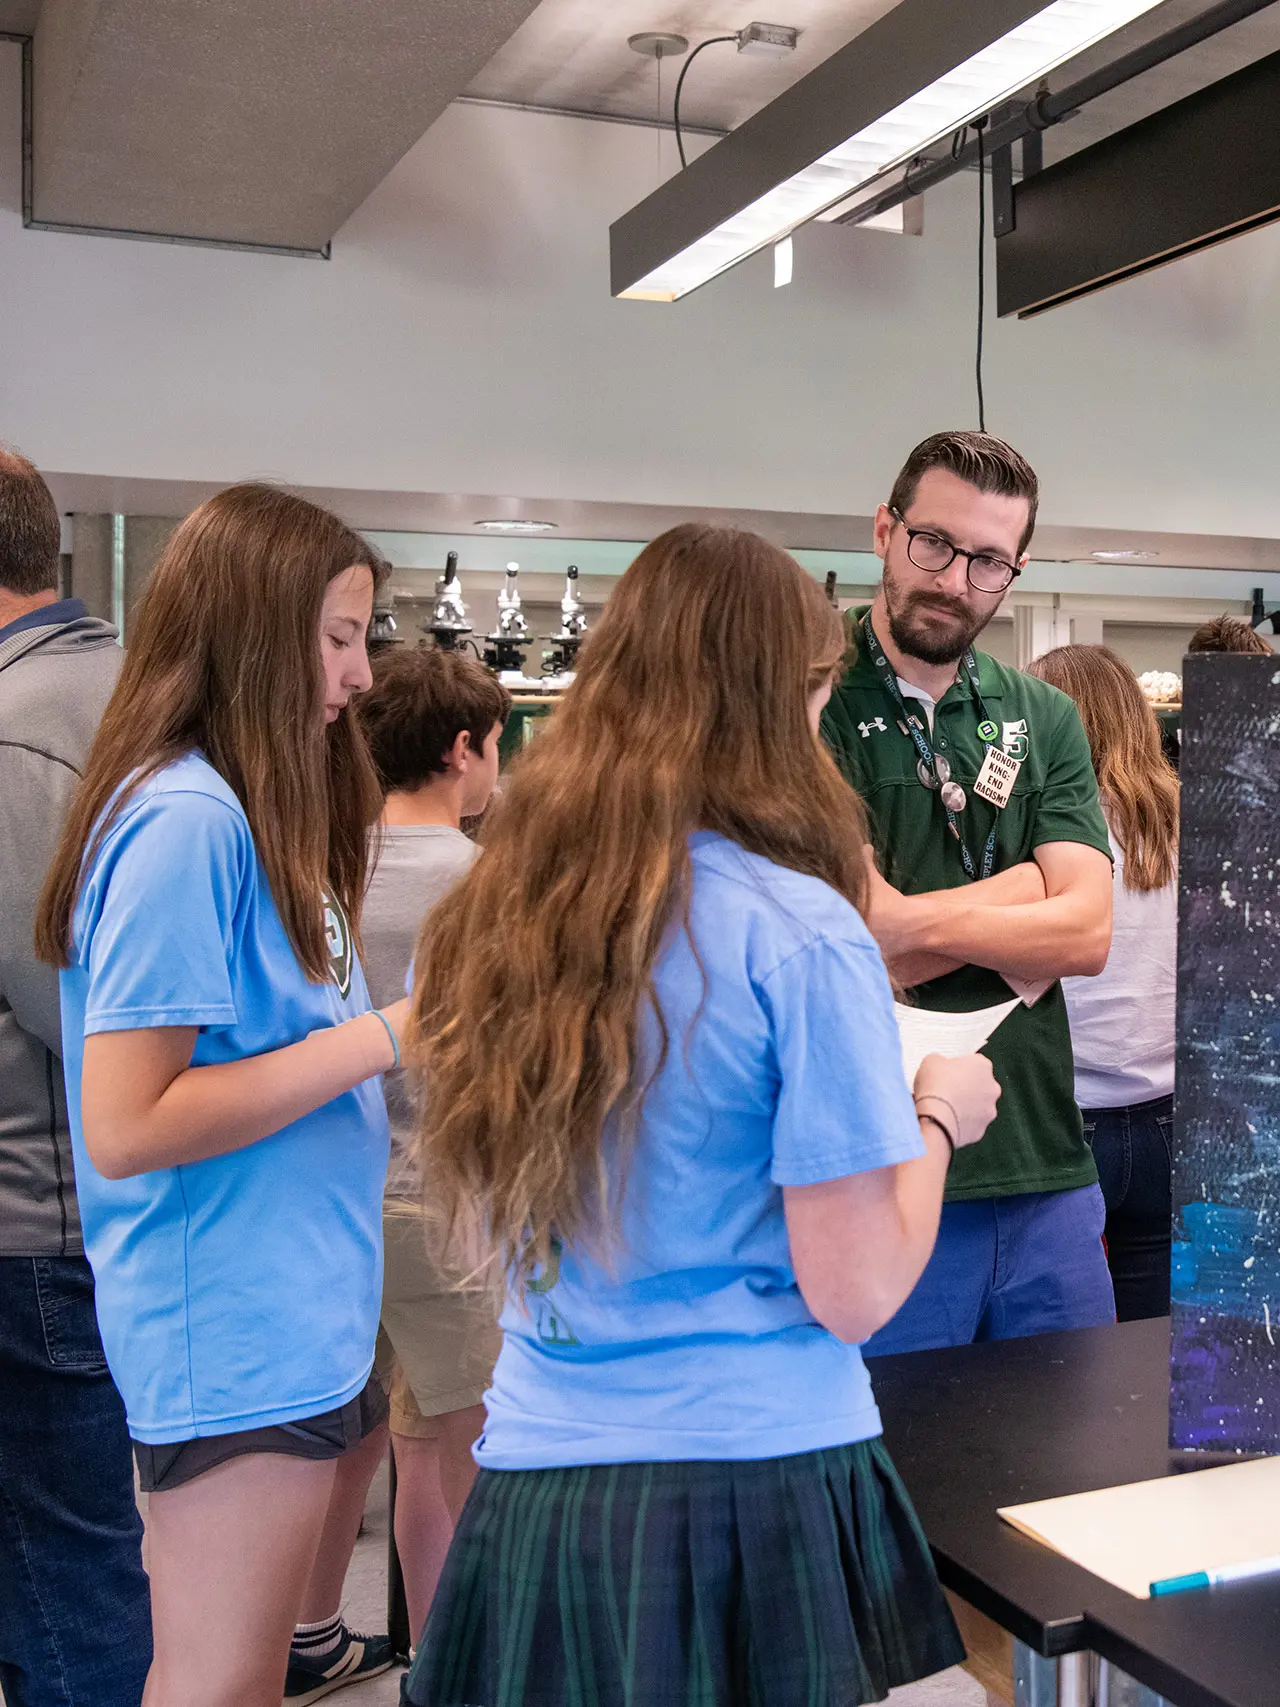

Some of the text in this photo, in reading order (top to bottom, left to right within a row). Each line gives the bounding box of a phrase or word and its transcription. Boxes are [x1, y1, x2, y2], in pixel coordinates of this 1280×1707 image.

[912, 729, 934, 766] SCHOOL
[990, 749, 1017, 771] HONOR
[987, 775, 1004, 790] END
[988, 762, 1011, 781] KING:
[975, 782, 1007, 806] RACISM!
